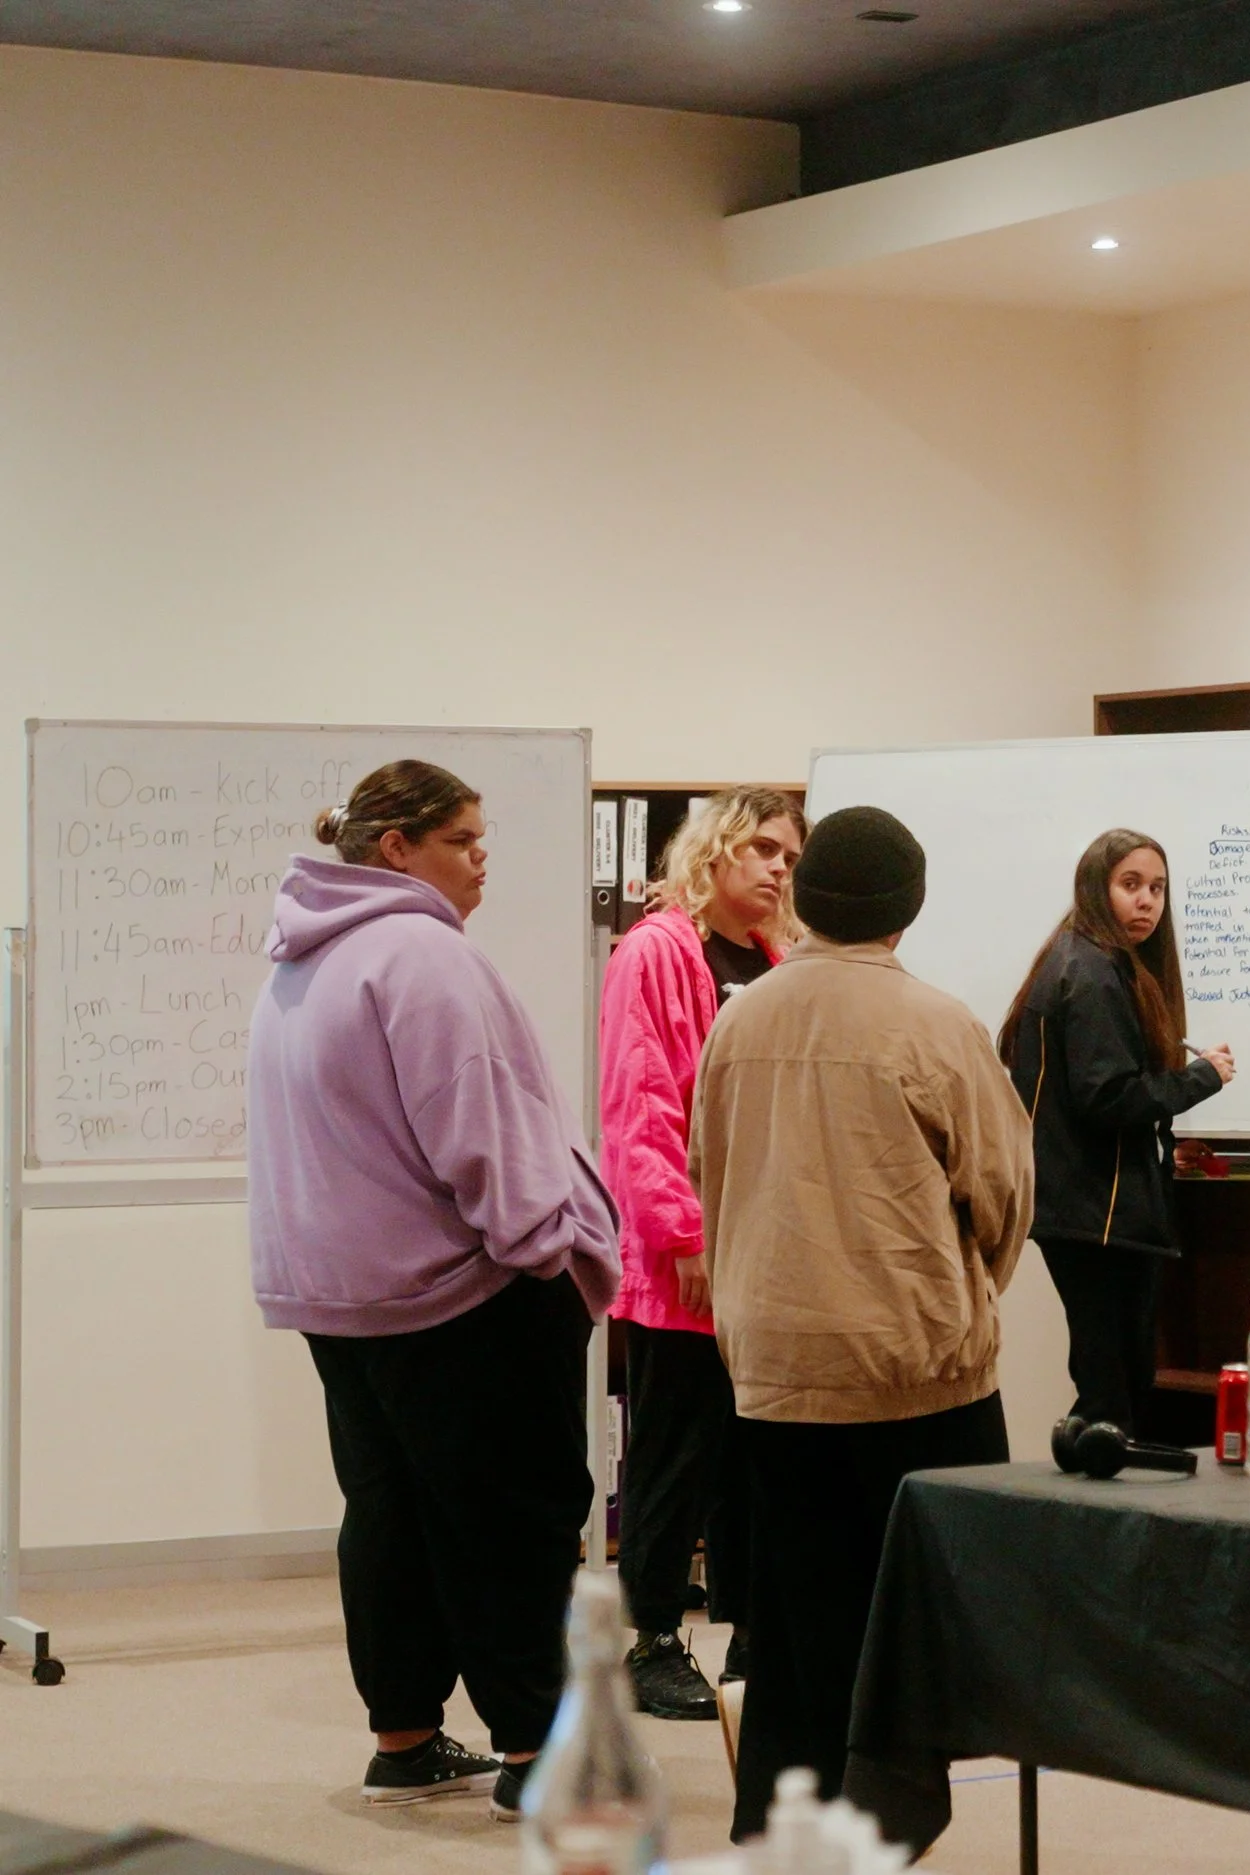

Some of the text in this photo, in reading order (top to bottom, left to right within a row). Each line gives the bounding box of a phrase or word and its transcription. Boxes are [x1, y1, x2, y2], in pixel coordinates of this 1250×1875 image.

[83, 762, 178, 808] 10am
[300, 758, 352, 799] off
[56, 819, 189, 859] 10:45am
[57, 866, 188, 914] 11:30am
[60, 921, 195, 973] 11:45am
[64, 983, 112, 1031] 1pm
[139, 973, 242, 1016] Lunch
[61, 1031, 165, 1072] 1:30pm
[55, 1071, 167, 1107] 2:15pm
[55, 1112, 116, 1152] 3pm
[140, 1105, 247, 1141] Closed
